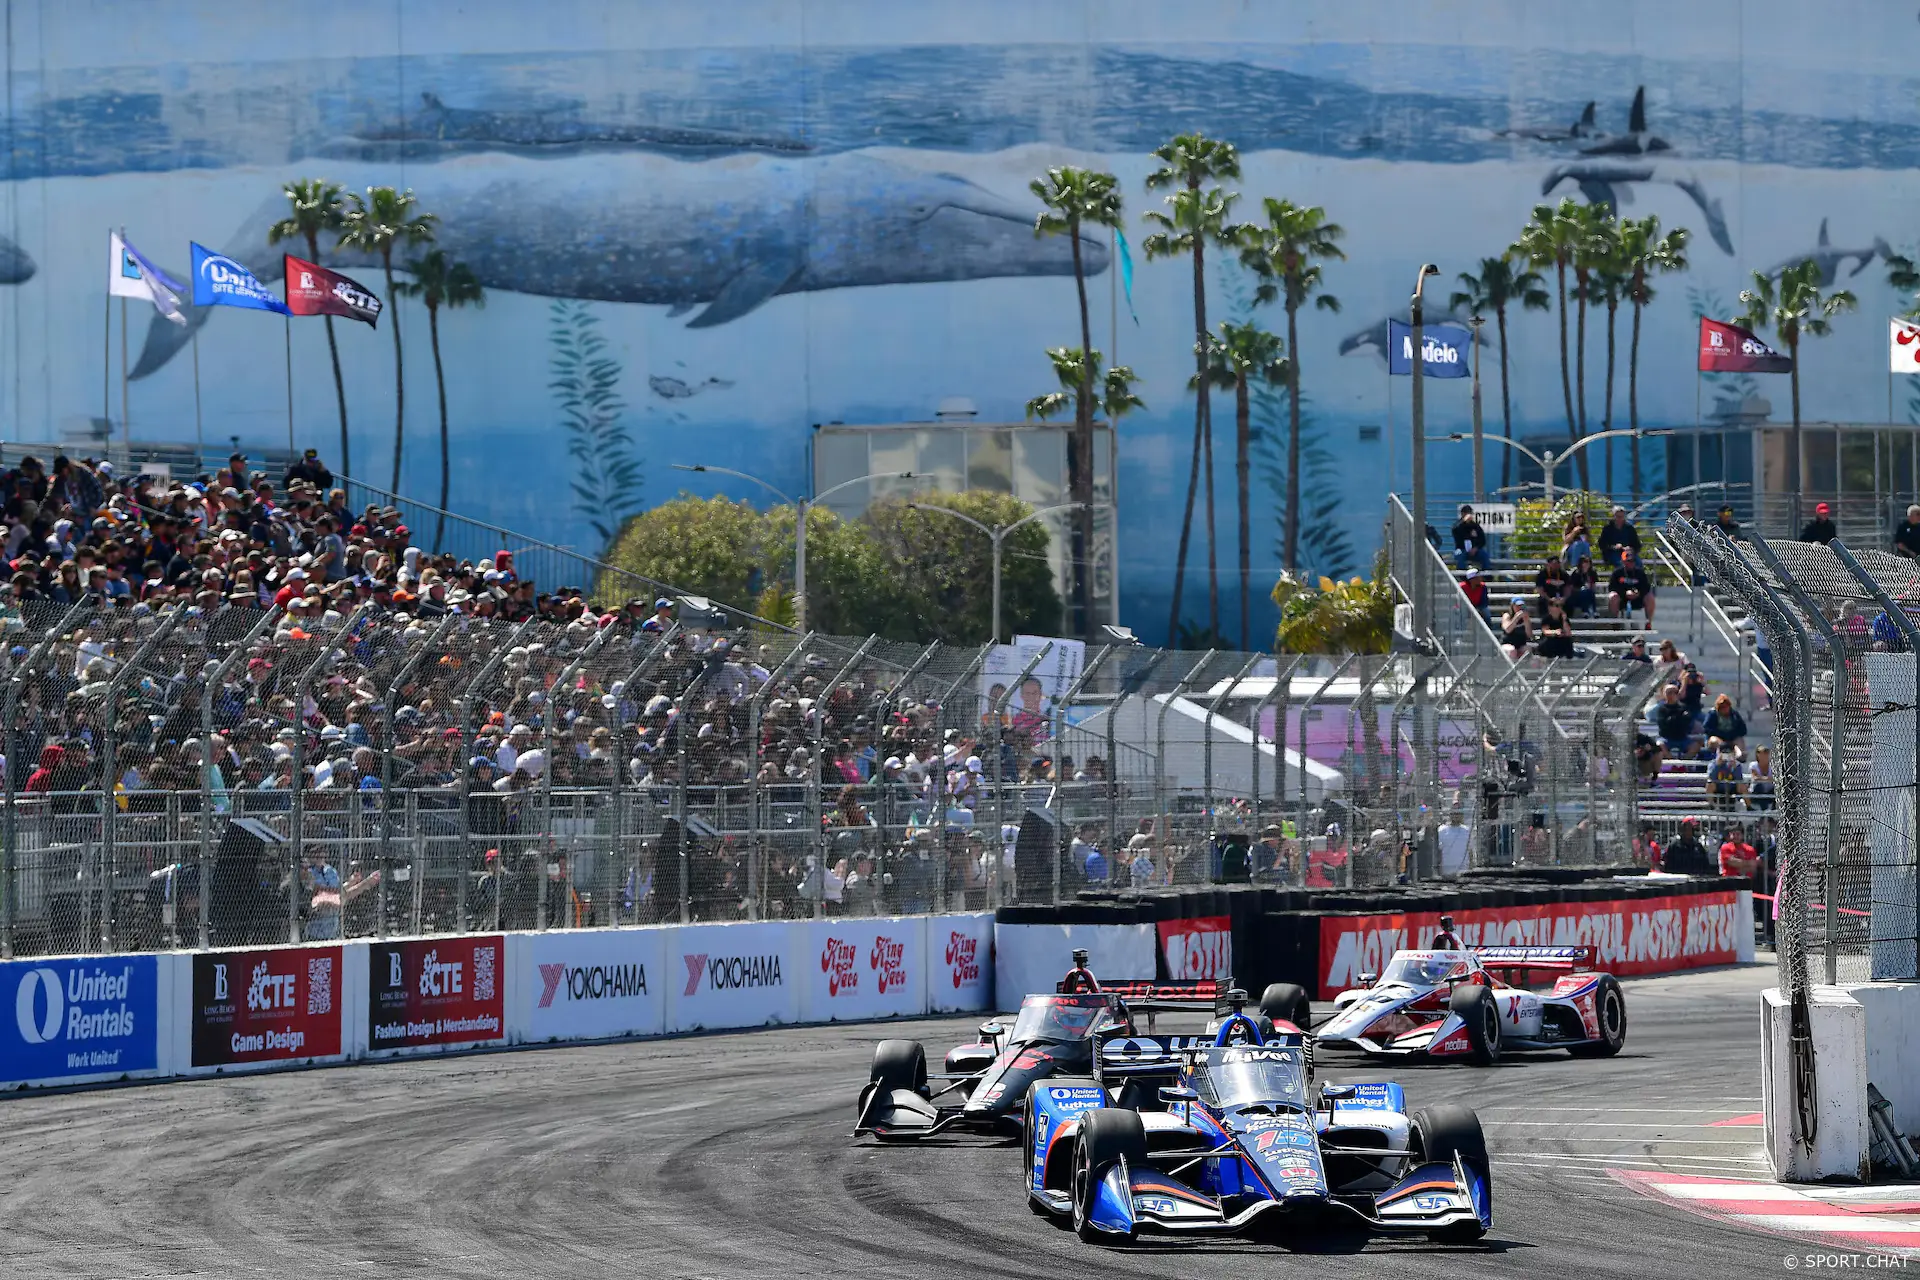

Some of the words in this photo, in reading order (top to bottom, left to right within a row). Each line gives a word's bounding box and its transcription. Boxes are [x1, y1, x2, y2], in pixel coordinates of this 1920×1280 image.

[821, 937, 857, 972] King
[871, 936, 904, 970] King
[945, 931, 977, 966] King
[68, 966, 129, 1003] United
[430, 962, 463, 996] CTE
[565, 964, 647, 1001] YOKOHAMA
[708, 955, 782, 990] YOKOHAMA
[829, 962, 859, 997] Taco
[879, 961, 906, 994] Taco
[953, 956, 979, 989] Taco
[258, 974, 296, 1010] CTE
[66, 1003, 135, 1040] Rentals
[374, 1022, 407, 1039] Fashion
[407, 1019, 435, 1038] Design
[436, 1018, 442, 1035] &
[443, 1013, 499, 1032] Merchandising
[231, 1032, 264, 1053] Game
[265, 1025, 305, 1053] Design
[1169, 1036, 1289, 1053] Untd
[67, 1053, 89, 1068] Work
[90, 1050, 119, 1066] United
